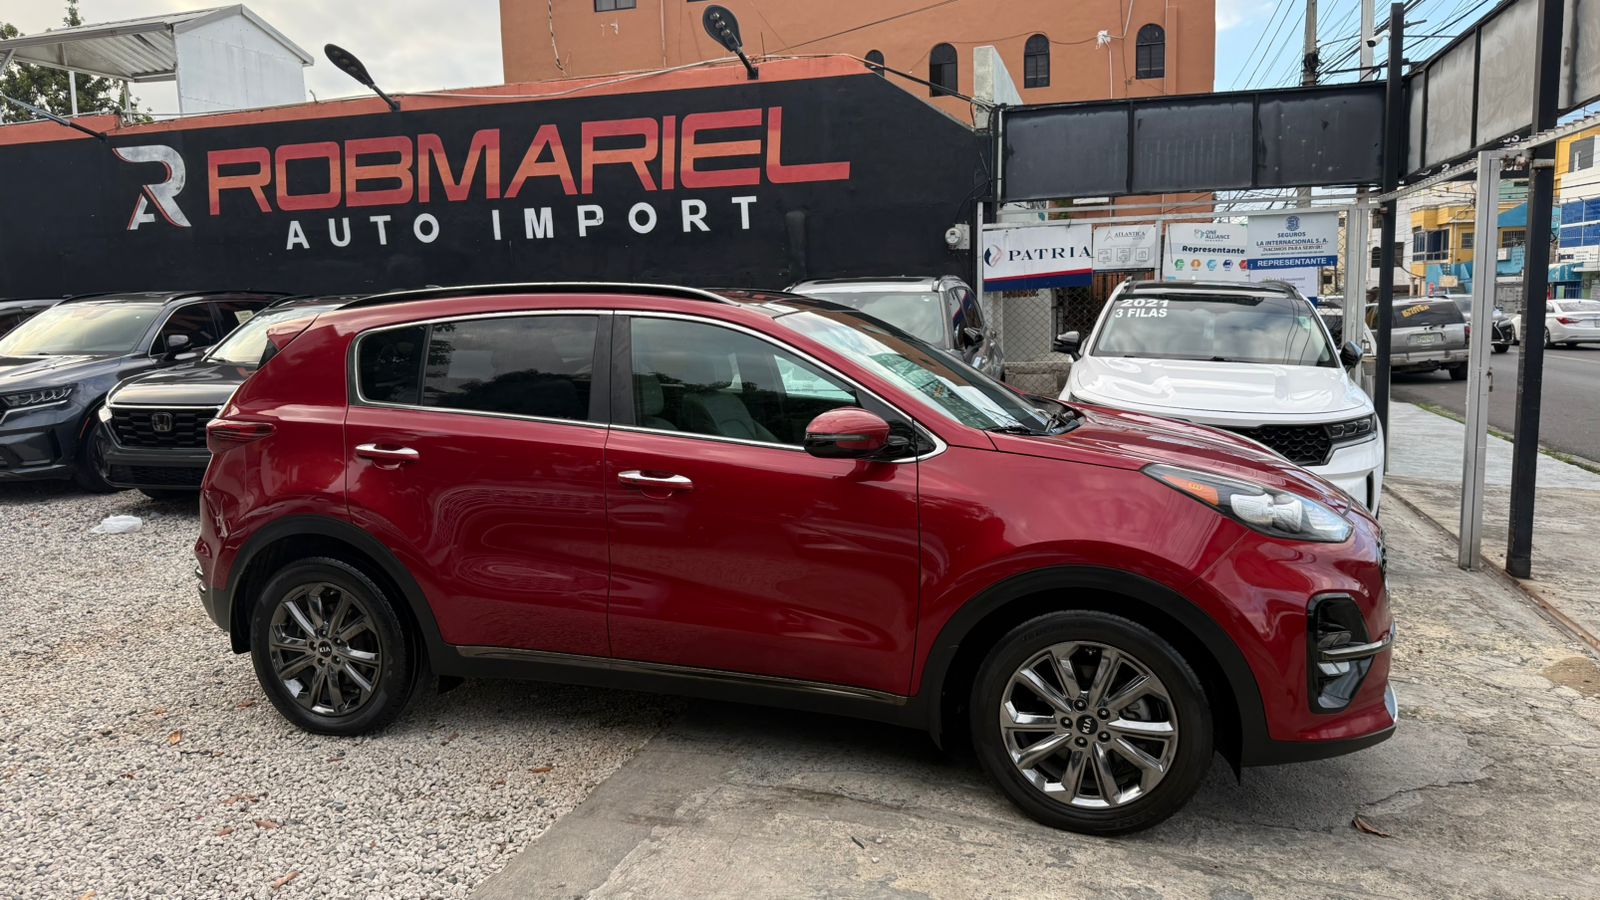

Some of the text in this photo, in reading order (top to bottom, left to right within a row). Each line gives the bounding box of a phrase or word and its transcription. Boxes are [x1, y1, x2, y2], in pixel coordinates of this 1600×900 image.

[207, 106, 850, 216] ROBMARIEL
[286, 195, 758, 250] AUTO IMPORT
[1265, 238, 1314, 246] INTERNACIONAL
[1008, 245, 1091, 261] PATRIA
[1182, 245, 1246, 254] Representante
[1257, 258, 1327, 267] REPRESENTANTE
[1120, 299, 1169, 307] 2021
[1115, 308, 1168, 318] 3 FILAS
[1082, 718, 1092, 733] KIA
